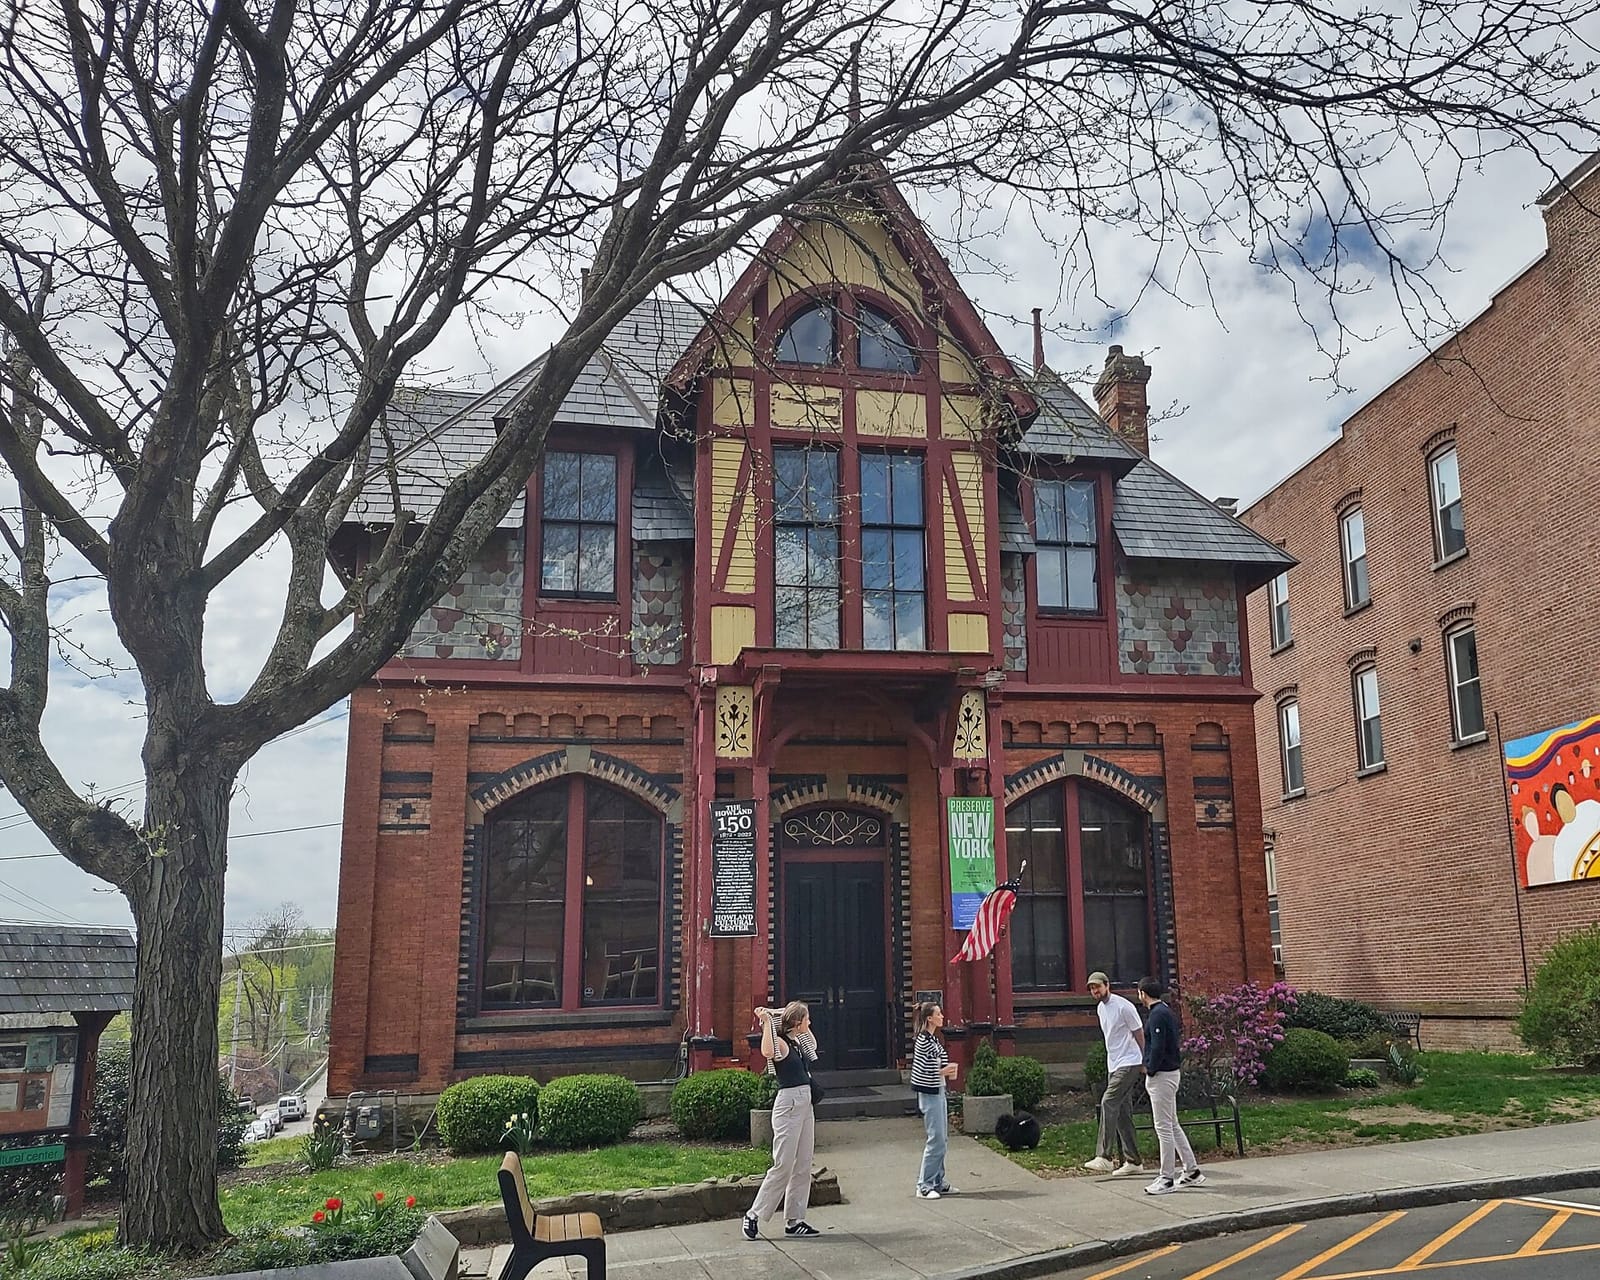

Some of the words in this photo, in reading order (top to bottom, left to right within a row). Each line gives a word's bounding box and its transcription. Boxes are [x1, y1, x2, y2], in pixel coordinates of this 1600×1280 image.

[950, 800, 991, 812] PRESERVE
[715, 808, 752, 817] HOWLAND
[717, 815, 752, 833] 150
[951, 812, 991, 838] NEW
[952, 838, 991, 858] YORK
[714, 919, 754, 927] CULTURAL
[26, 1150, 58, 1162] center
